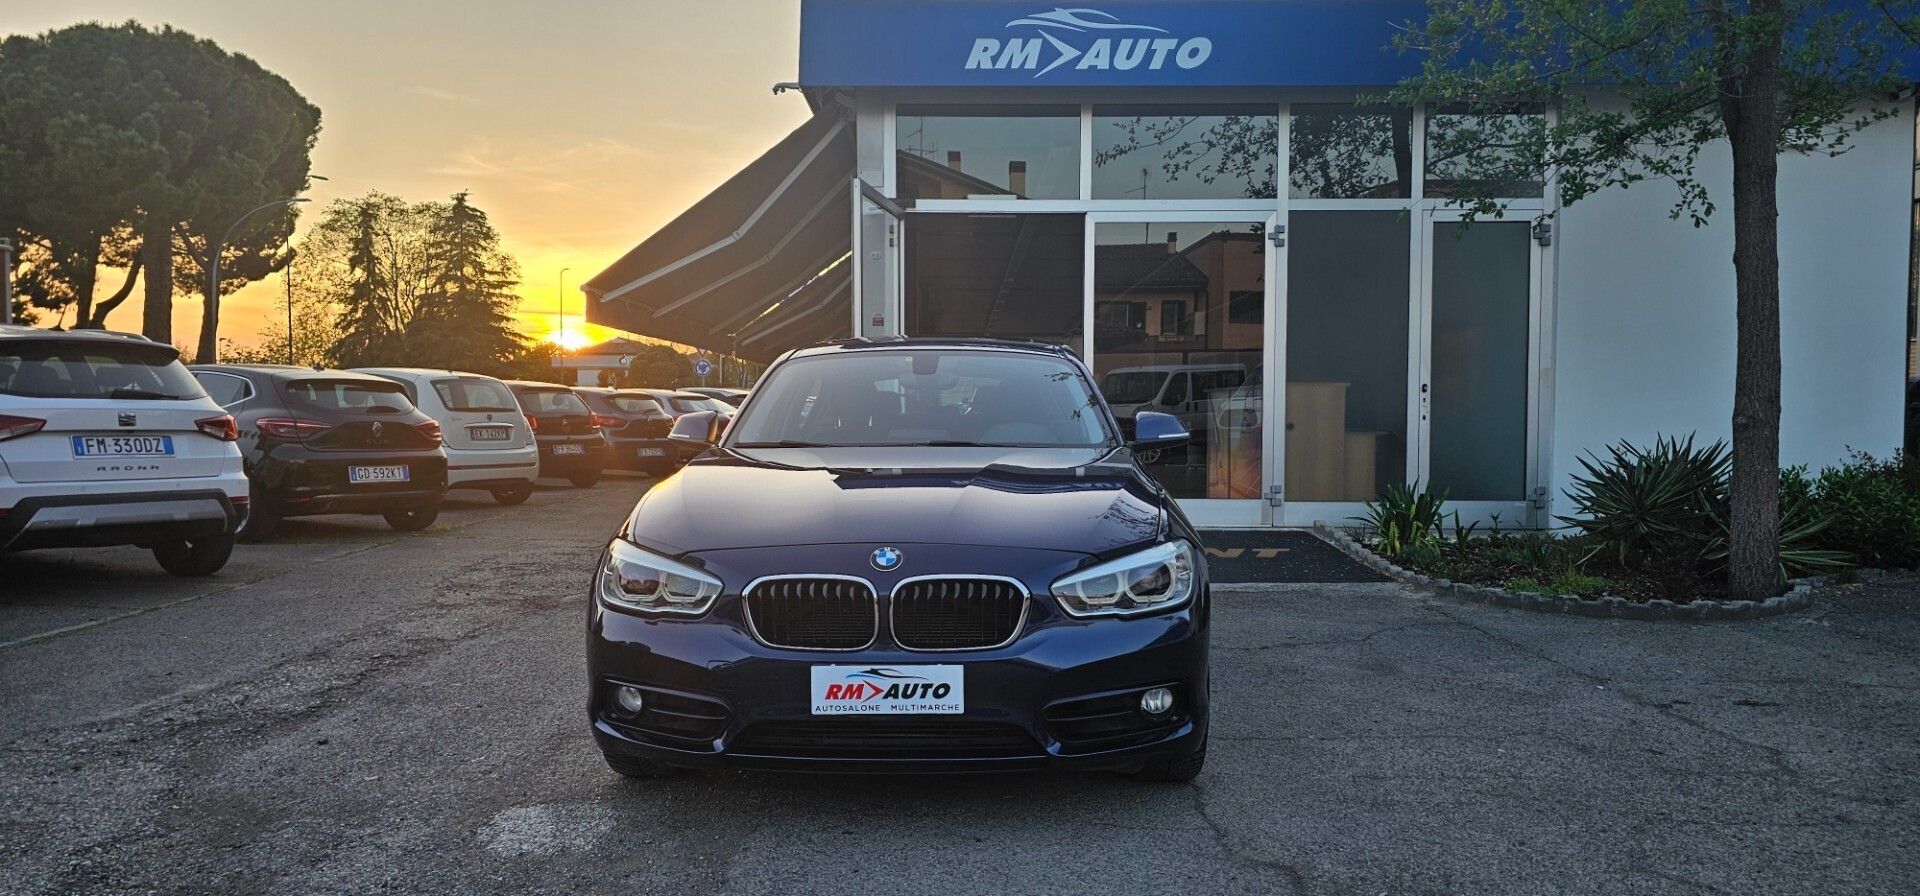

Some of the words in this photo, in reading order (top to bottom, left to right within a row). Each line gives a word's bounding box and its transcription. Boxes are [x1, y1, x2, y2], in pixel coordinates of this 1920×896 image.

[964, 38, 1043, 69] RM
[1075, 36, 1213, 70] AUTO
[824, 683, 865, 699] RM
[882, 682, 951, 699] AUTO
[815, 704, 880, 712] AUTOSALONE
